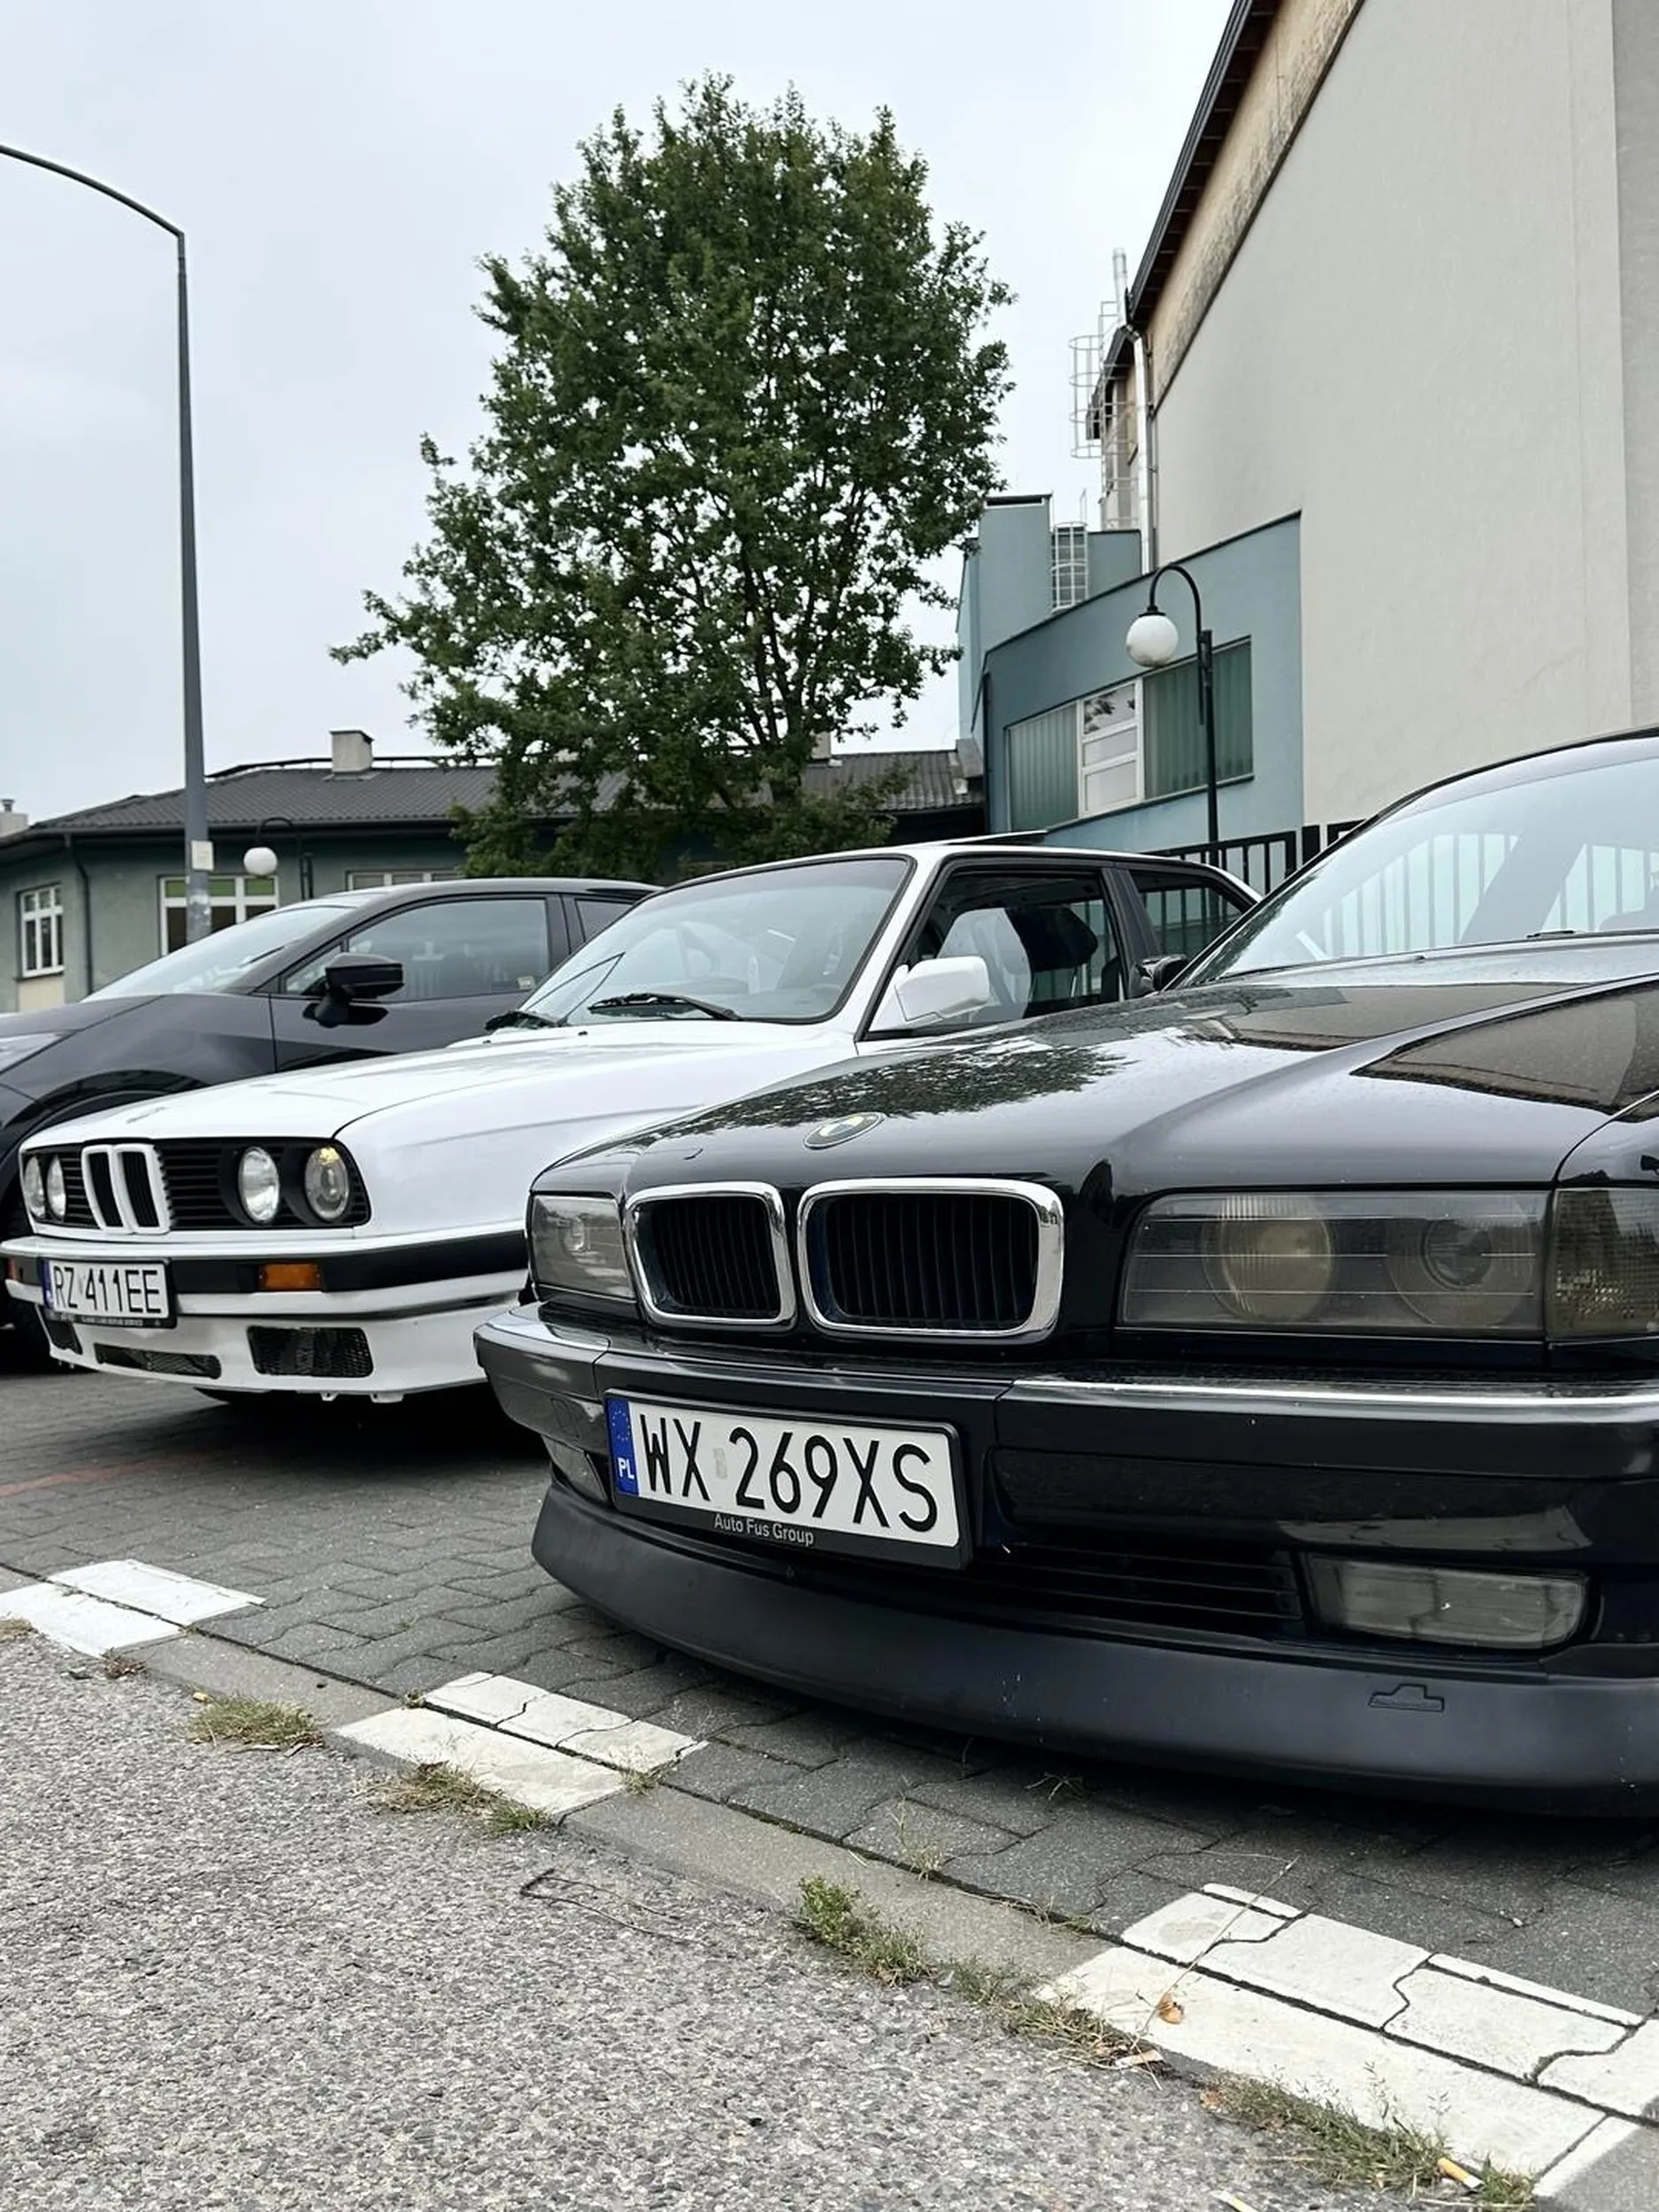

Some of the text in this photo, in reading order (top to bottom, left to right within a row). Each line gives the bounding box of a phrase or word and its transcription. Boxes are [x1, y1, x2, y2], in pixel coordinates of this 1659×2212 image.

[53, 1265, 162, 1314] RZ 411EE
[617, 1458, 635, 1480] PL
[639, 1413, 939, 1532] WX 269XS
[714, 1513, 814, 1547] Auto Fus Group
